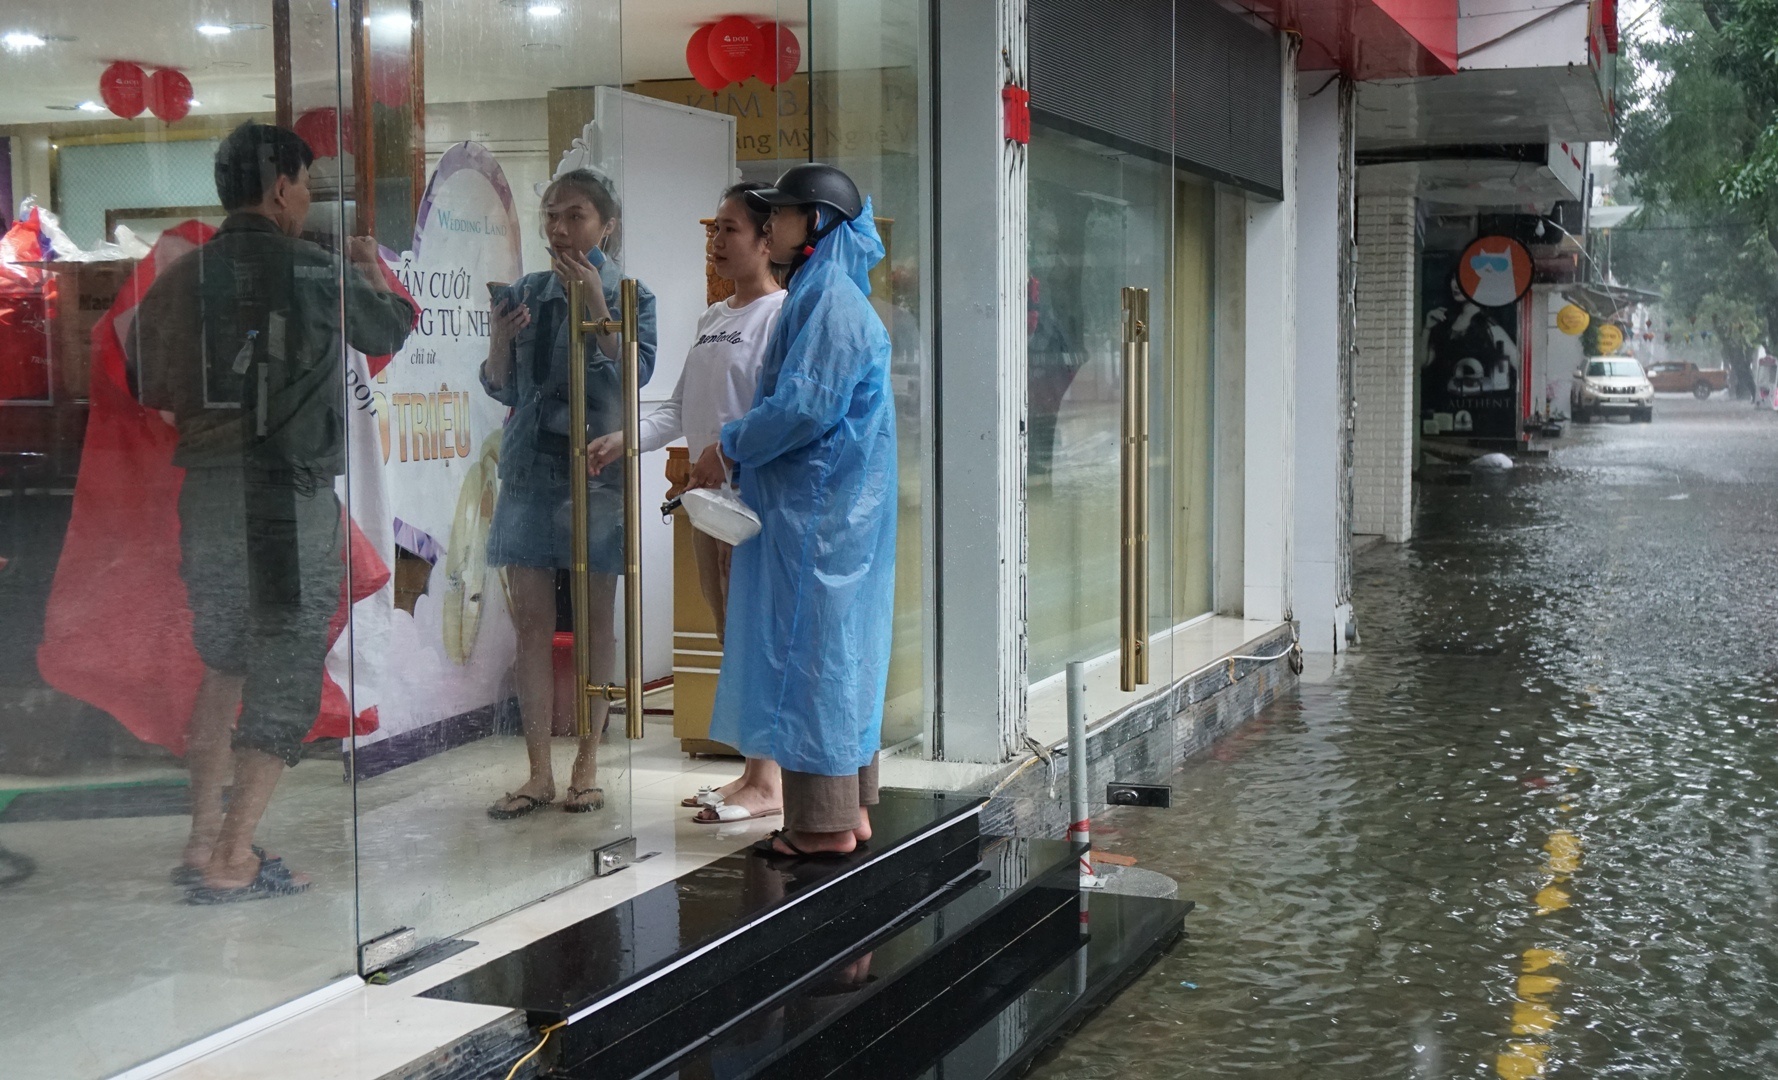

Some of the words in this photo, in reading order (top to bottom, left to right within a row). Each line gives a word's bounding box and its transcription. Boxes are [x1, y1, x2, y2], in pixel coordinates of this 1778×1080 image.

[429, 266, 472, 300] CƯỚI
[438, 305, 461, 342] TỰ
[410, 348, 425, 365] chỉ
[426, 350, 437, 365] từ
[392, 382, 471, 468] TRIỆU
